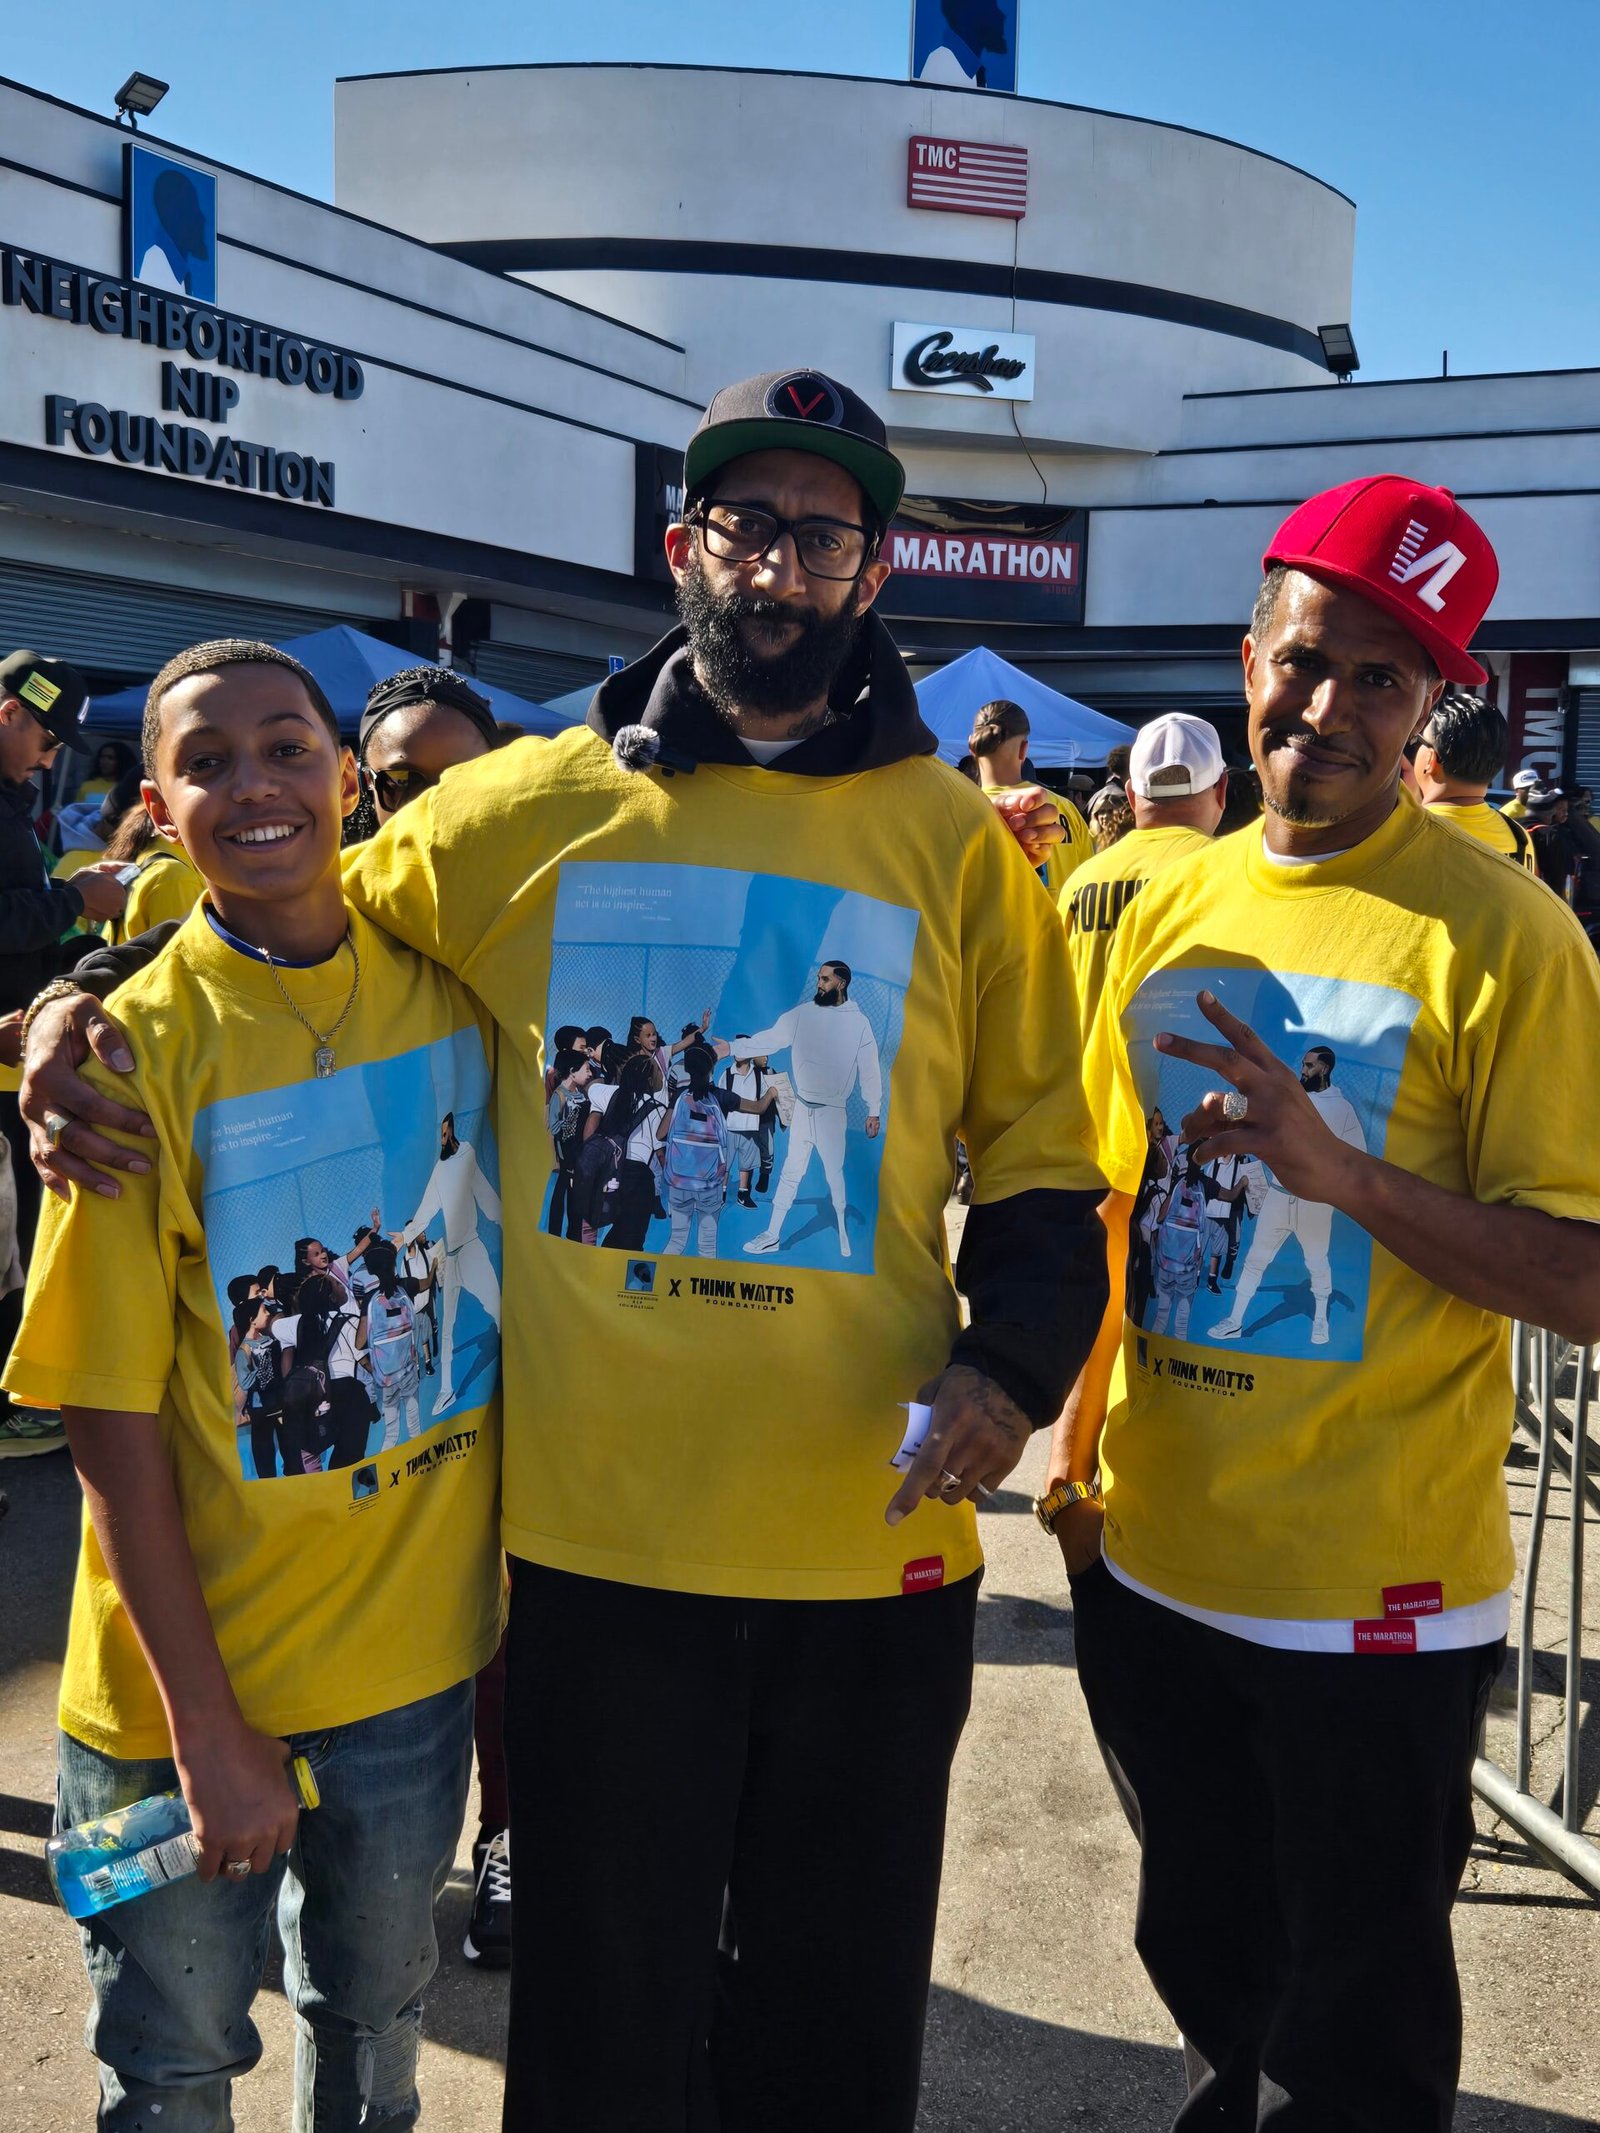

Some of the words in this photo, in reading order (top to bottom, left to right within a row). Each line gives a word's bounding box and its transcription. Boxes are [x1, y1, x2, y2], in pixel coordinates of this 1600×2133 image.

[916, 143, 957, 170] TMC
[2, 252, 365, 401] NEIGHBORHOOD
[162, 361, 240, 423] NIP
[45, 394, 335, 507] FOUNDATION
[893, 537, 1072, 579] MARATHON
[668, 1279, 682, 1298] X
[690, 1277, 736, 1299] THINK
[740, 1282, 795, 1305] WATTS
[706, 1299, 777, 1311] FOUNDATION
[1153, 1358, 1163, 1377] X
[1167, 1358, 1198, 1381] THINK
[1202, 1366, 1255, 1392] WATTS
[1172, 1379, 1235, 1397] FOUNDATION
[389, 1469, 401, 1488] X
[433, 1429, 478, 1460] WATTS
[1388, 1604, 1401, 1612] THE
[1402, 1598, 1440, 1610] MARATHON
[1358, 1632, 1371, 1640] THE
[1373, 1631, 1412, 1640] MARATHON
